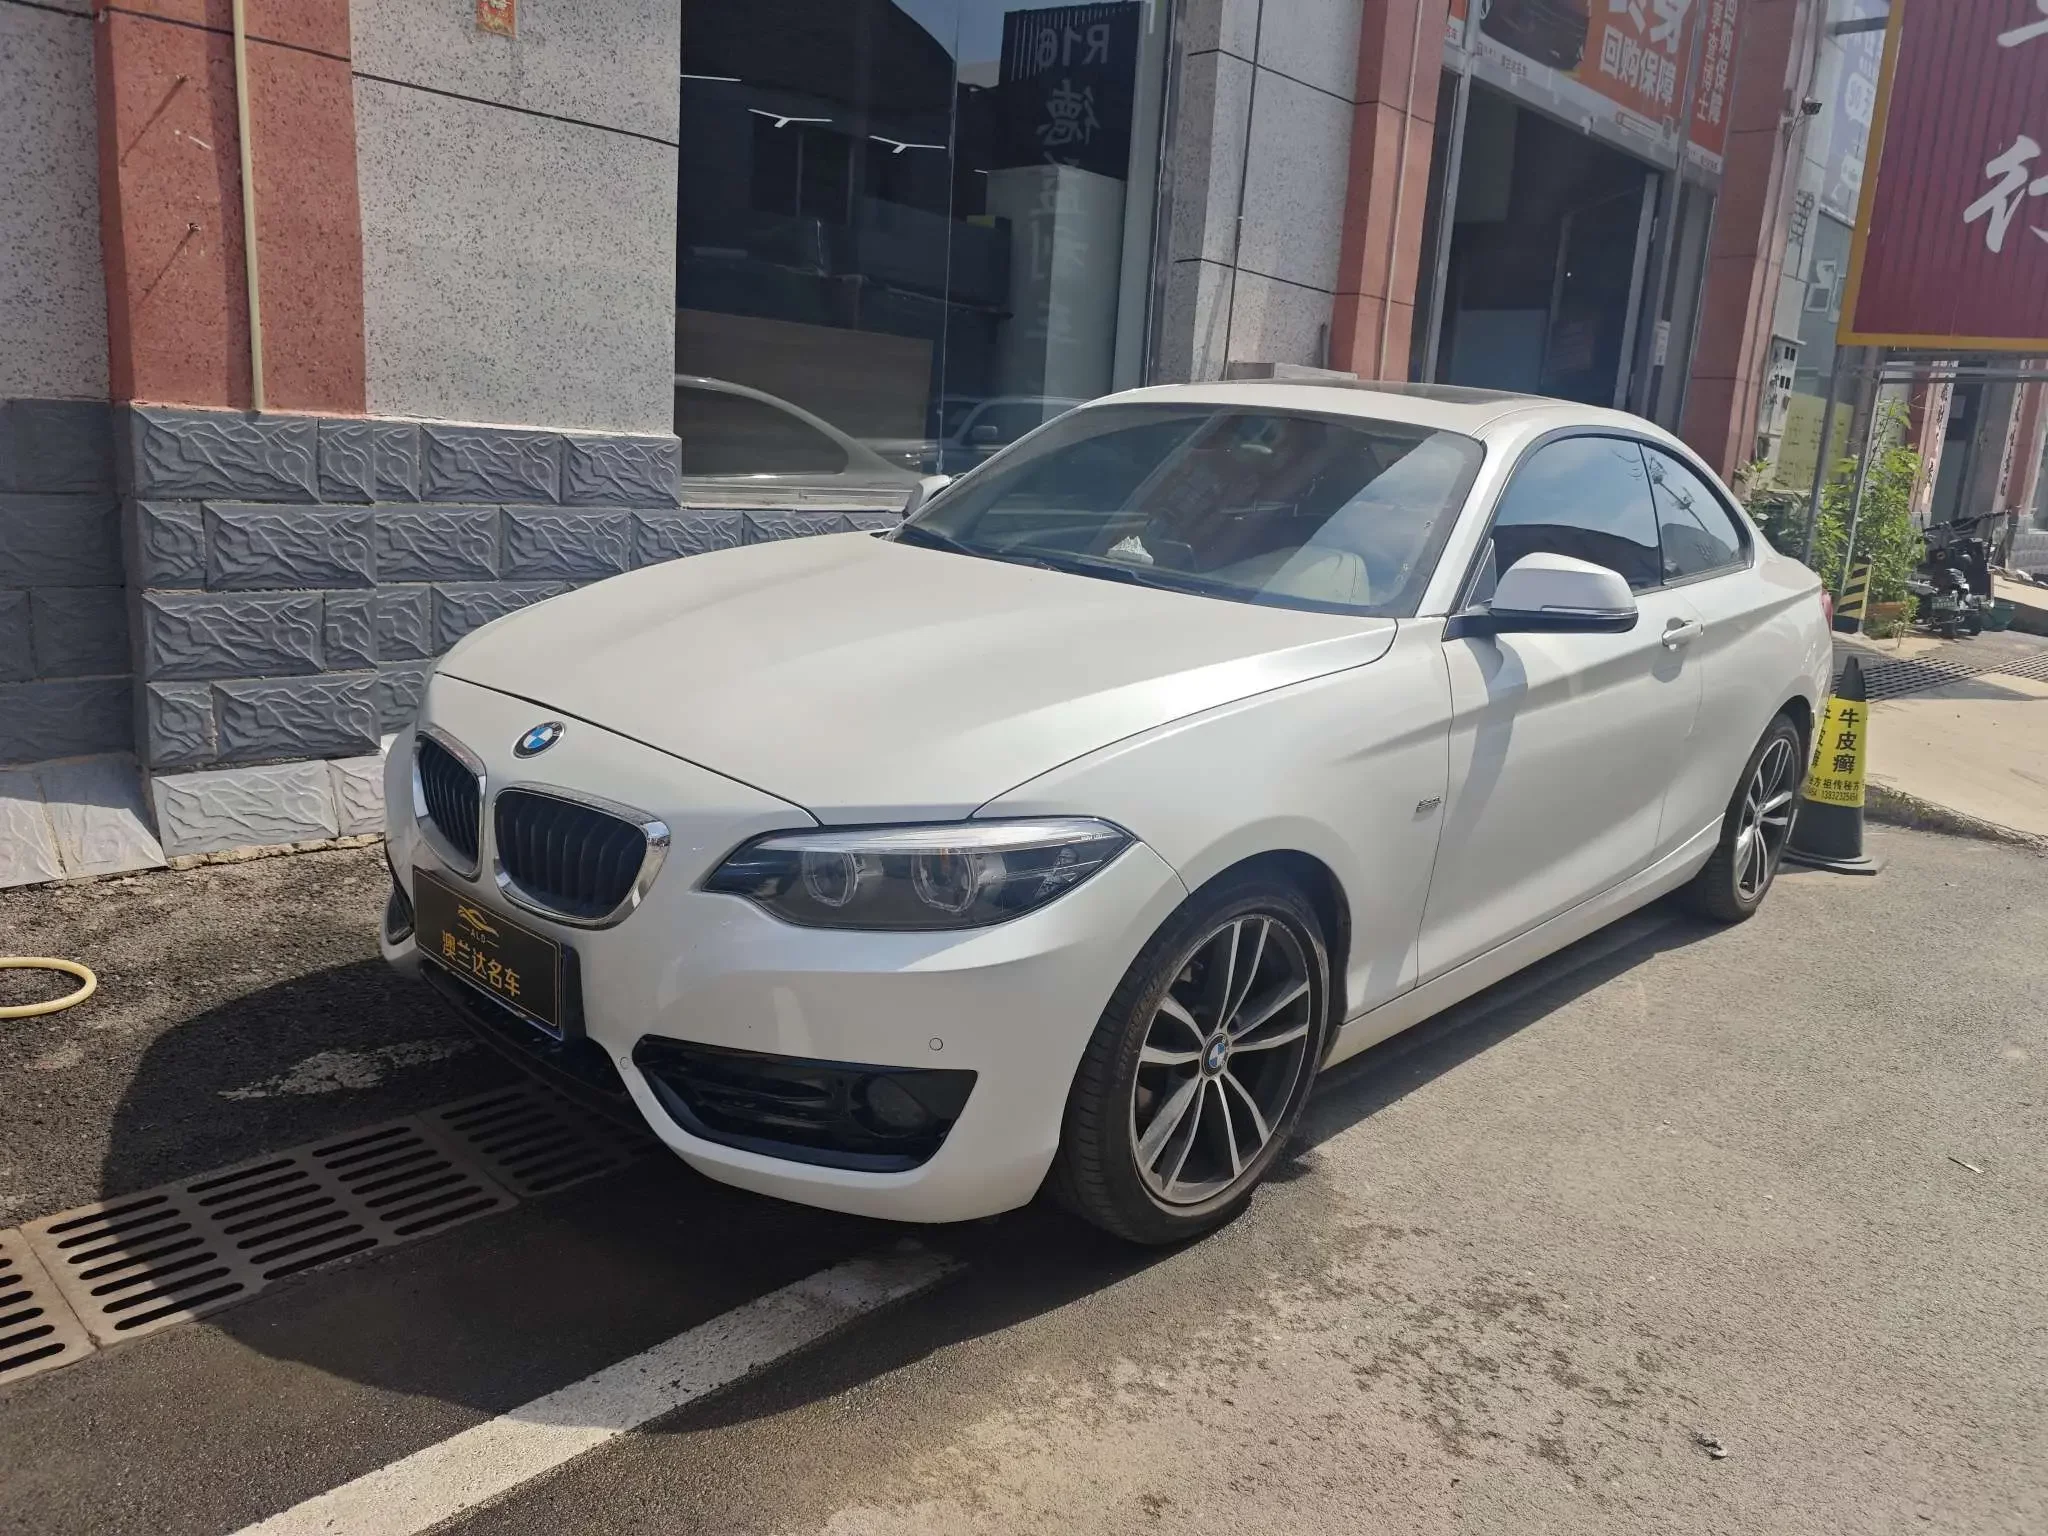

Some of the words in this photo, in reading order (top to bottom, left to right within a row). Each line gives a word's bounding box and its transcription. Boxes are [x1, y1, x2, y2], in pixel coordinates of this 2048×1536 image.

[1600, 24, 1676, 107] 回购保障
[1833, 707, 1859, 774] 牛皮癣
[442, 930, 521, 997] 澳兰达名车
